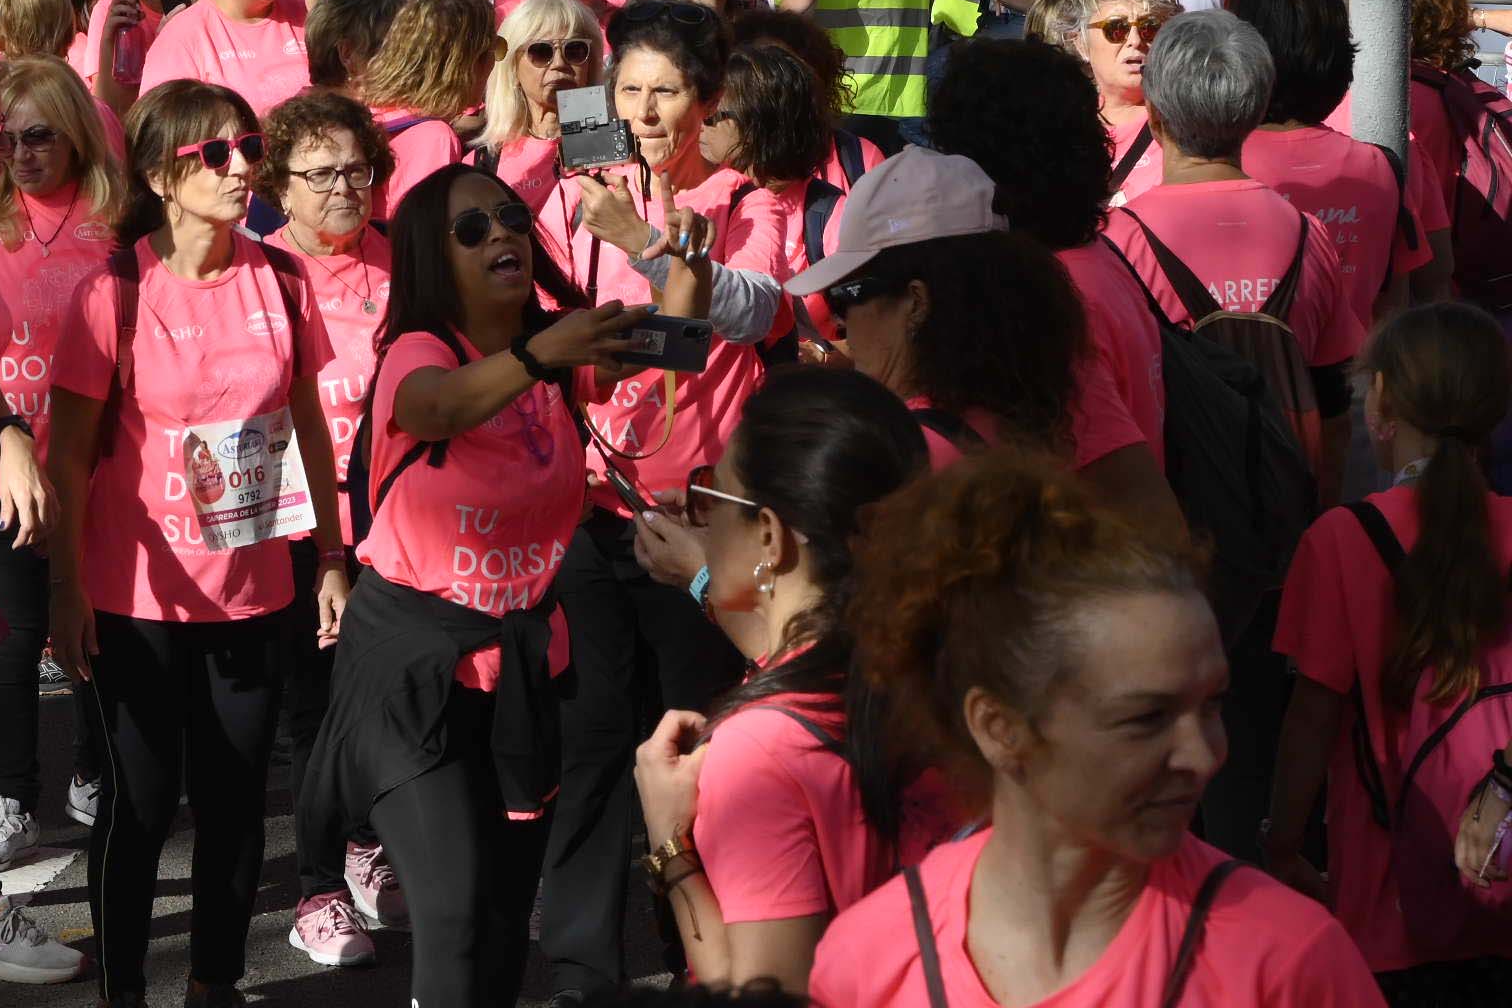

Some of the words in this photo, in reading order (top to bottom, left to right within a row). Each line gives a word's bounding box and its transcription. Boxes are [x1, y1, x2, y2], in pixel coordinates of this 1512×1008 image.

[12, 320, 30, 345] U
[322, 374, 367, 407] TU
[331, 416, 363, 444] D
[164, 472, 187, 502] D
[229, 465, 265, 489] 016
[238, 489, 261, 505] 9792
[279, 497, 296, 507] 2023
[264, 513, 304, 529] Santander
[456, 504, 500, 535] TU
[450, 580, 530, 612] SUM
